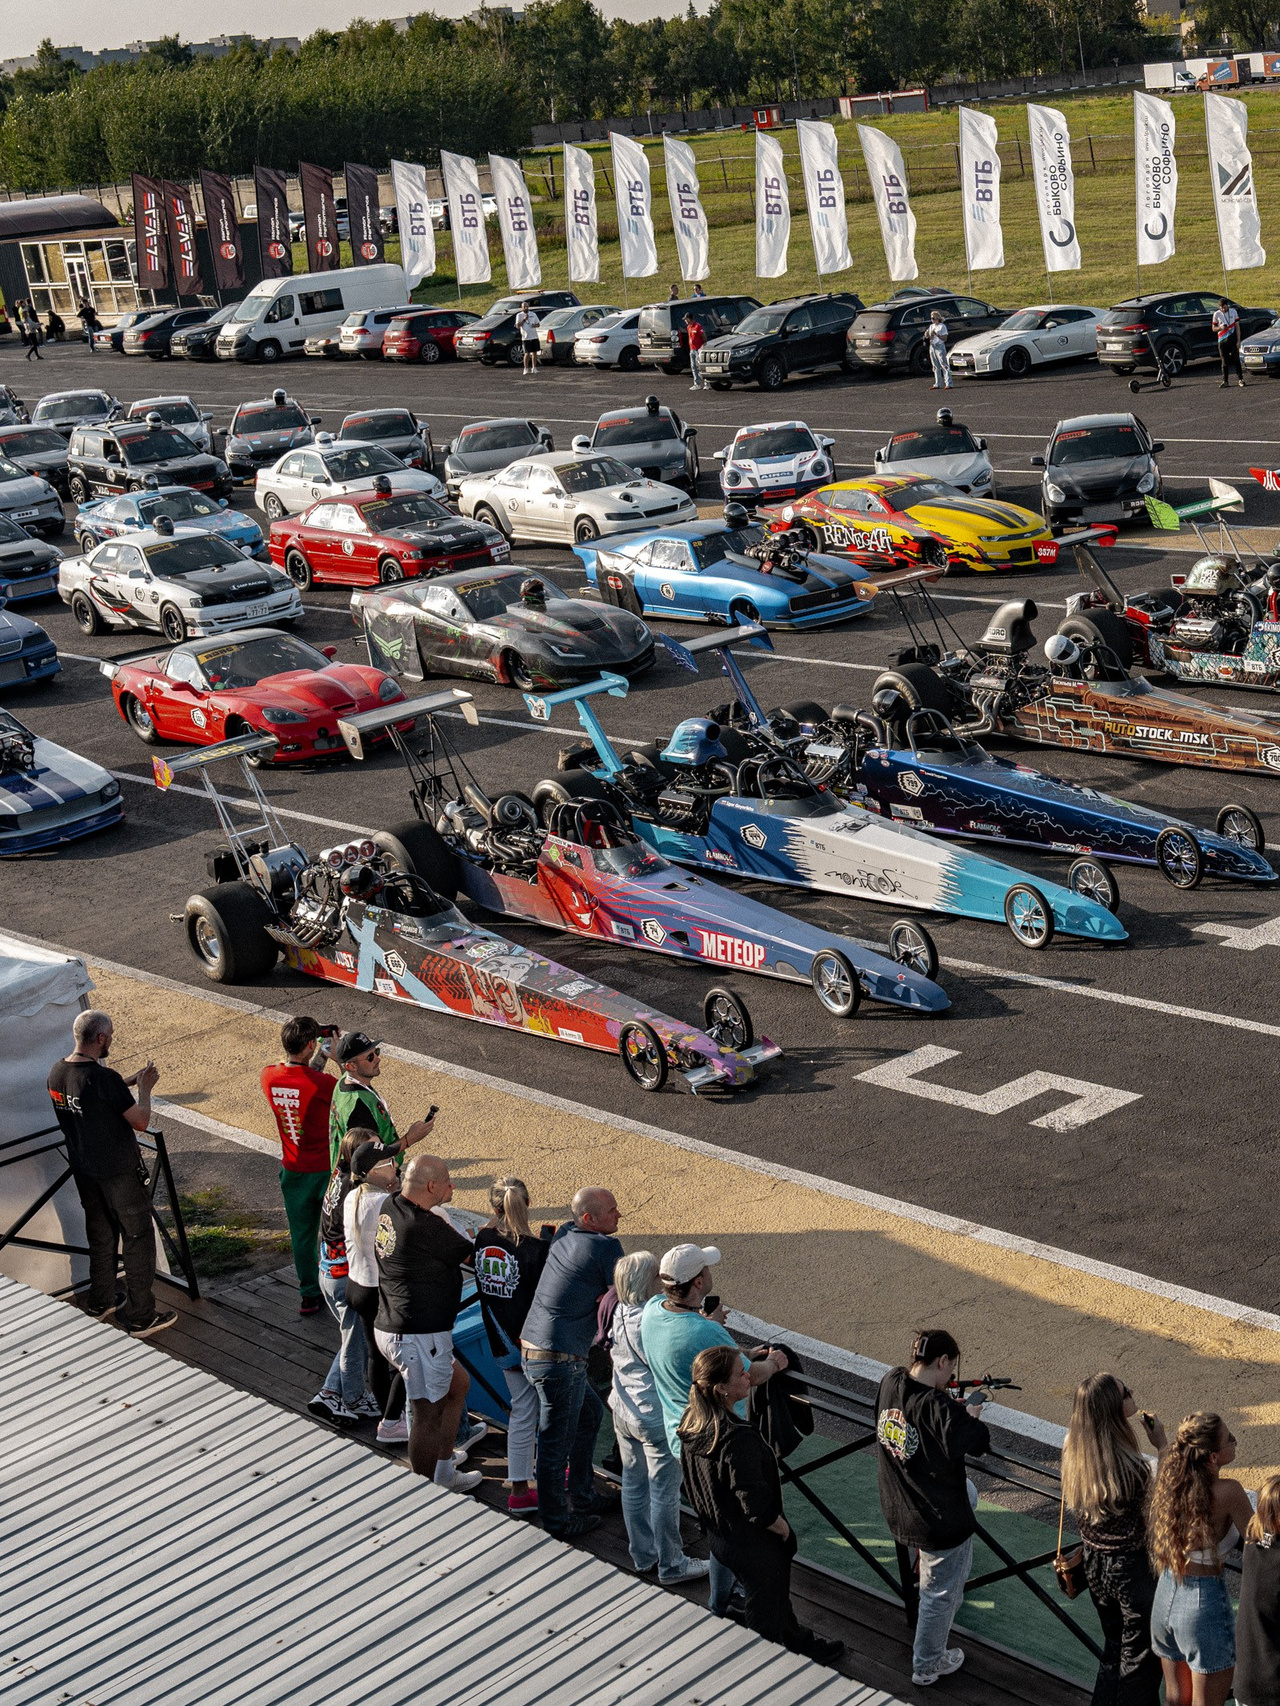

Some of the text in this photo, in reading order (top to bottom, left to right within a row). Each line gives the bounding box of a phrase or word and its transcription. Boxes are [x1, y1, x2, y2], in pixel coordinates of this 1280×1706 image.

[1054, 132, 1067, 191] СОФЬИНО
[1160, 123, 1172, 185] СОФЬИНО
[629, 179, 645, 217] ВТБ
[764, 176, 782, 216] ВТБ
[819, 167, 837, 209] ВТБ
[884, 174, 907, 215] ВТБ
[974, 160, 993, 202] ВТБ
[1048, 165, 1062, 216] БЫКОВО
[1152, 156, 1162, 209] БЫКОВО
[409, 201, 427, 236] ВТБ
[462, 192, 479, 228] ВТБ
[510, 195, 528, 233] ВТБ
[573, 188, 591, 226] ВТБ
[680, 182, 699, 220] ВТБ
[702, 932, 765, 967] МЕТЕОР
[853, 1042, 1143, 1134] 5
[483, 1258, 509, 1278] GAT
[481, 1282, 514, 1298] FAMILY
[884, 1422, 906, 1447] GAT
